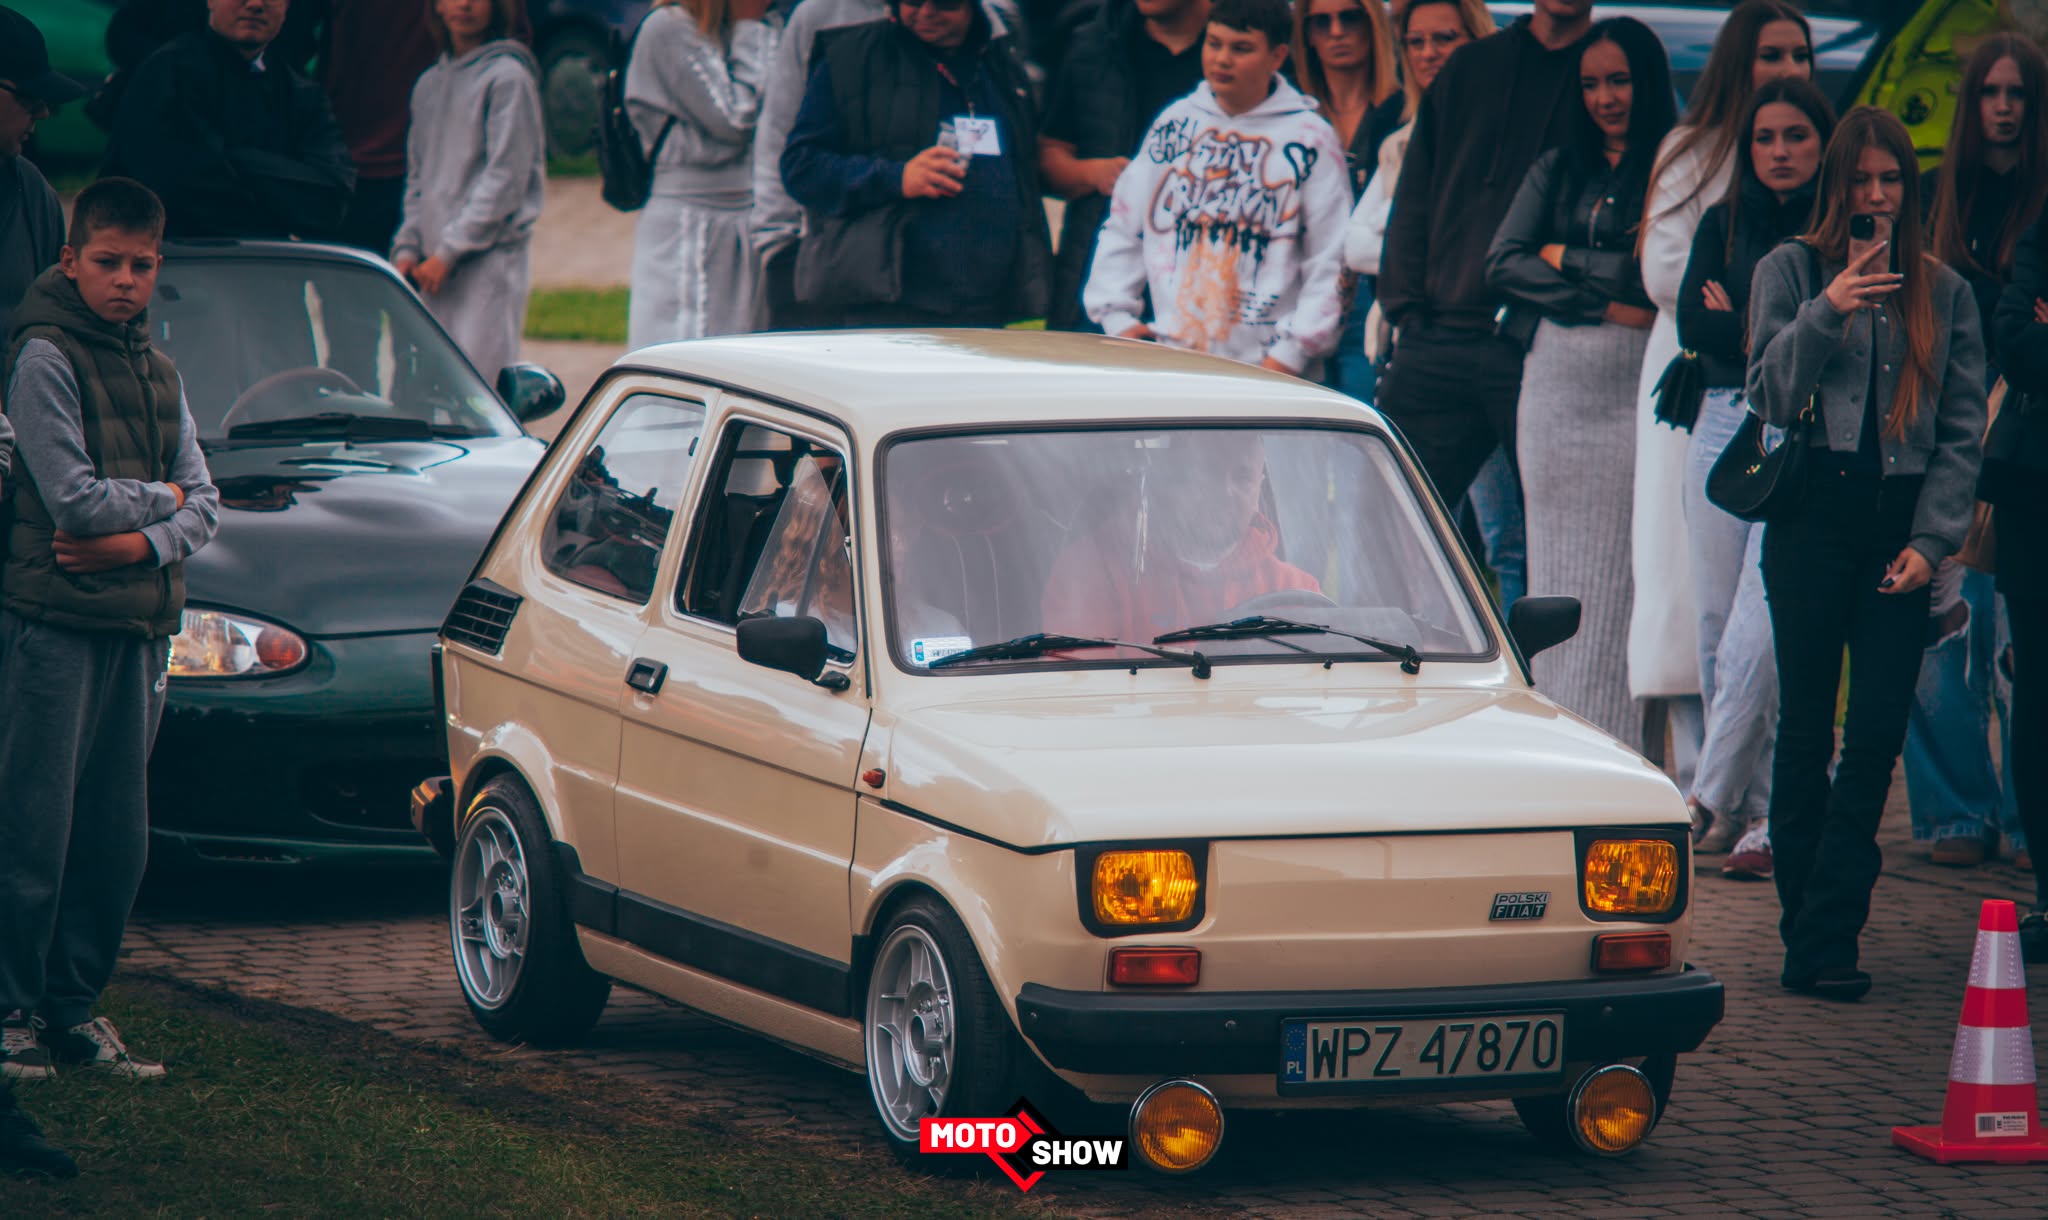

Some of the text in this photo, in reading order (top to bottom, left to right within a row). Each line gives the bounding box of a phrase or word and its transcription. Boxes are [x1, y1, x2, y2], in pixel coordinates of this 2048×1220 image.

[1499, 894, 1548, 904] POLSKI
[1496, 905, 1544, 917] FIAT
[1312, 1019, 1558, 1078] WPZ 47870
[1286, 1061, 1304, 1075] PL
